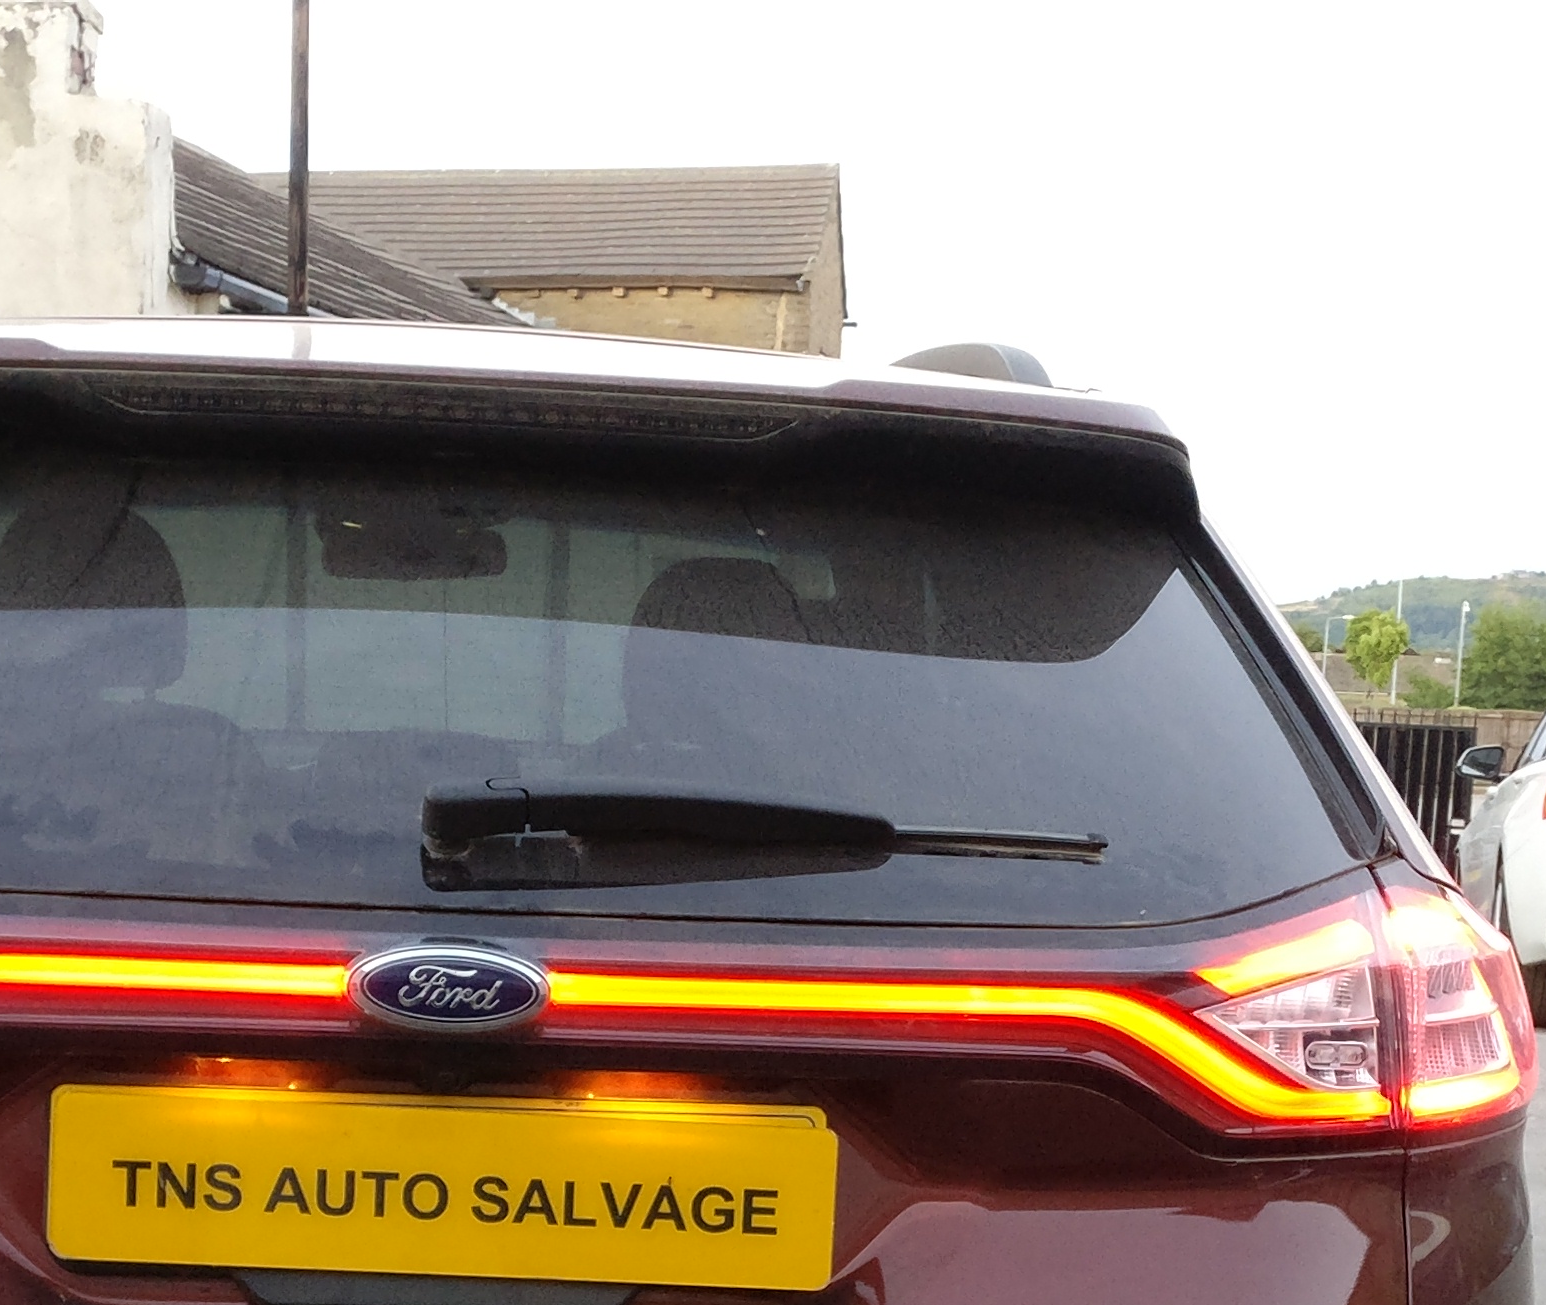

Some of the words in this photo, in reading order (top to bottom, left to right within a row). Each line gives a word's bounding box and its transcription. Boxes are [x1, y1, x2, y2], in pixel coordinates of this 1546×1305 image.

[398, 965, 503, 1010] Ford
[112, 1160, 242, 1212] TNS
[263, 1166, 449, 1220] AUTO
[470, 1175, 779, 1236] SALVAGE
